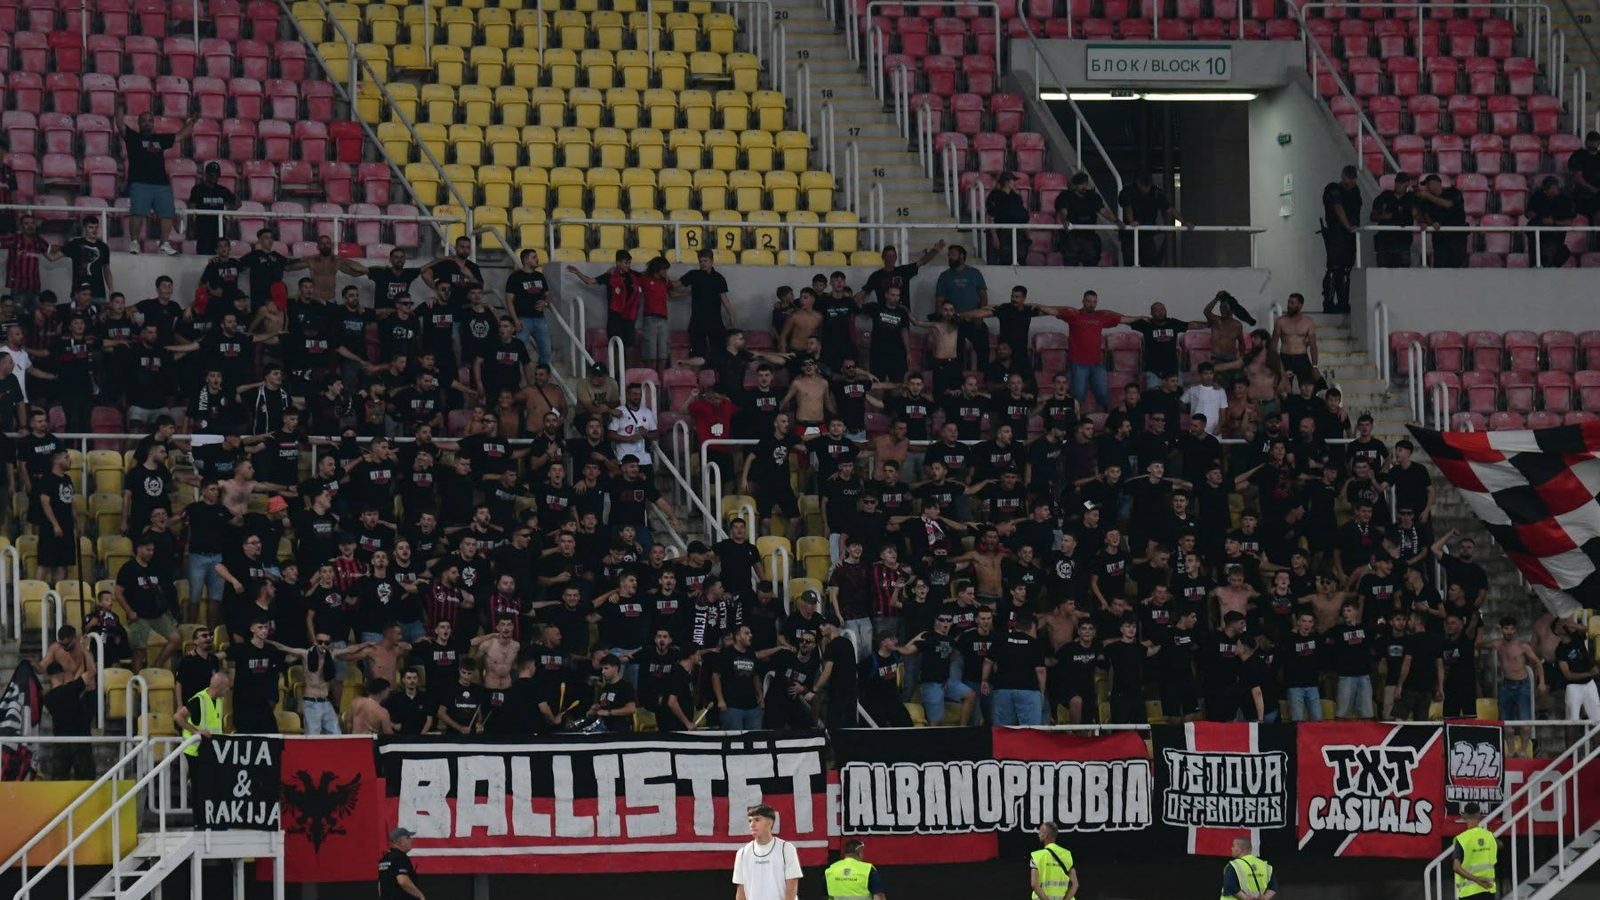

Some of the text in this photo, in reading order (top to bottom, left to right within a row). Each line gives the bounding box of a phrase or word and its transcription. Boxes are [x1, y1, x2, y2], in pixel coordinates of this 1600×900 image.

[775, 11, 789, 20] 20
[797, 50, 809, 59] 19
[1091, 59, 1139, 72] БЛОК
[1151, 59, 1200, 72] BLOCK
[1205, 57, 1227, 75] 10
[822, 89, 833, 99] 18
[849, 128, 861, 137] 17
[872, 168, 885, 178] 16
[896, 208, 909, 217] 15
[725, 232, 735, 250] 9
[762, 234, 776, 249] 2
[212, 740, 272, 766] VIJA
[1454, 741, 1499, 779] 22
[232, 770, 252, 798] &
[1166, 750, 1284, 795] TETOVA
[1322, 745, 1418, 798] TXT
[843, 760, 1152, 835] ALBANOPHOBIA
[1166, 793, 1284, 824] OFFENDERS
[205, 799, 281, 826] RAKIJA
[1308, 799, 1434, 836] CASUALS
